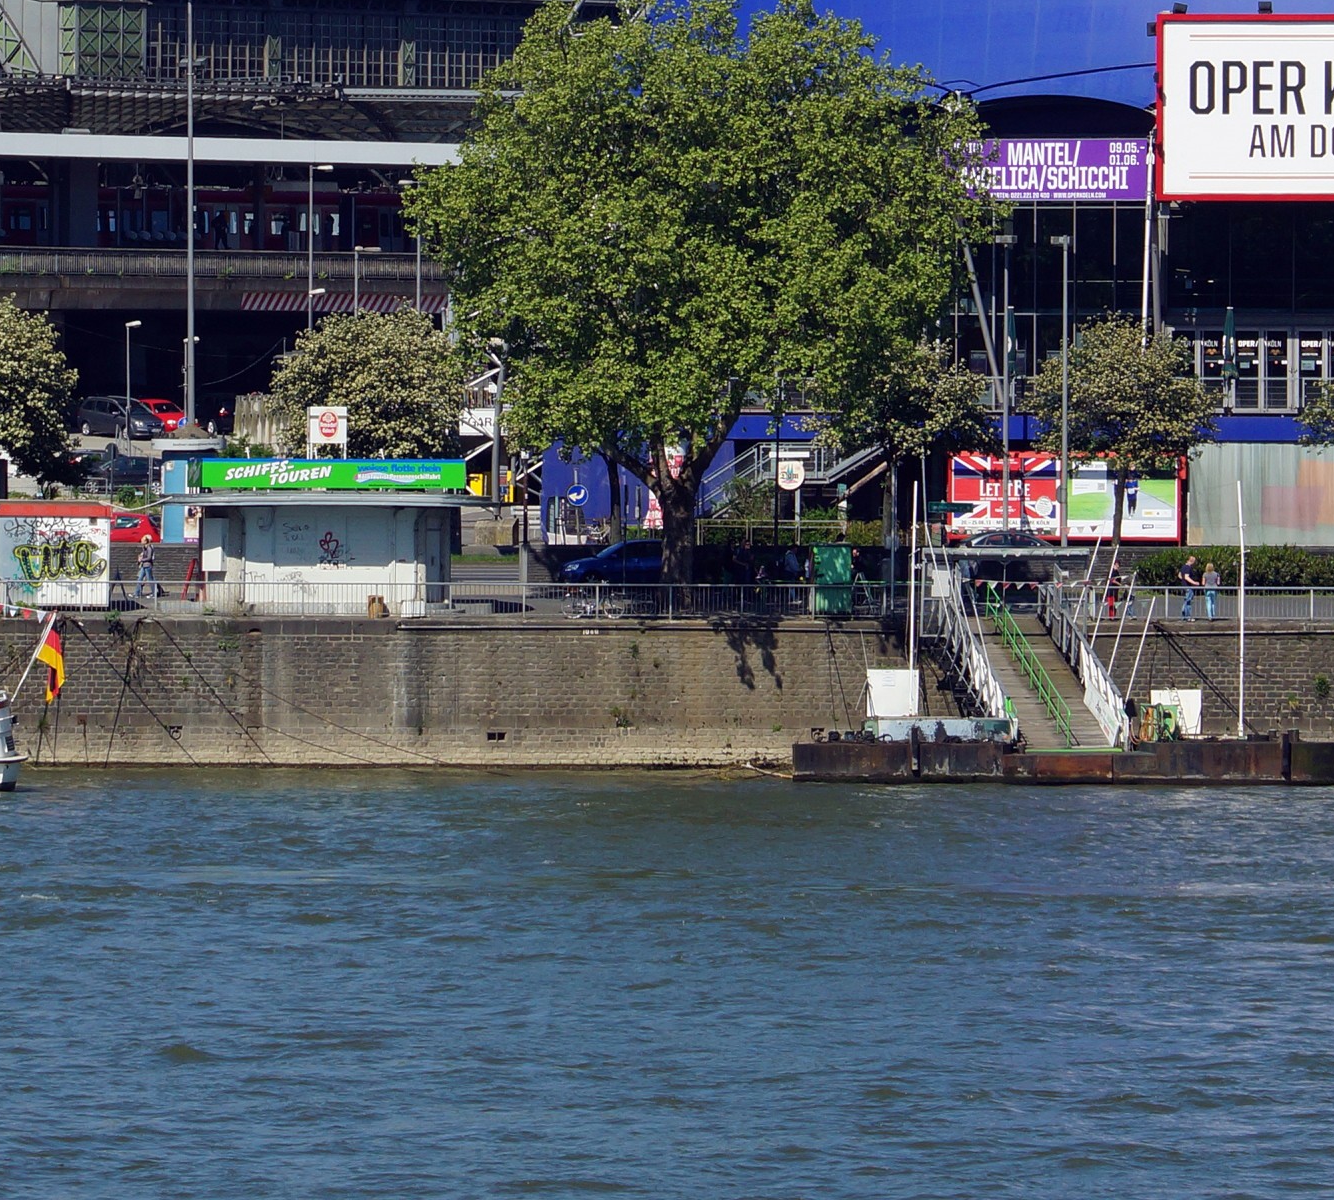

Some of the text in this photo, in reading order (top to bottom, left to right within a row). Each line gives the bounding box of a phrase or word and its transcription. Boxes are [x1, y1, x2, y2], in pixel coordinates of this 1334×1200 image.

[1189, 60, 1306, 115] OPER
[1109, 142, 1145, 153] 09.05.-
[1249, 124, 1295, 158] AM
[1008, 141, 1081, 167] MANTEL/
[1109, 155, 1139, 166] 01.06.
[225, 460, 295, 481] SCHIFFS-
[270, 465, 332, 486] TOUREN
[357, 463, 442, 473] weisse flotte rhein
[979, 480, 999, 497] LET
